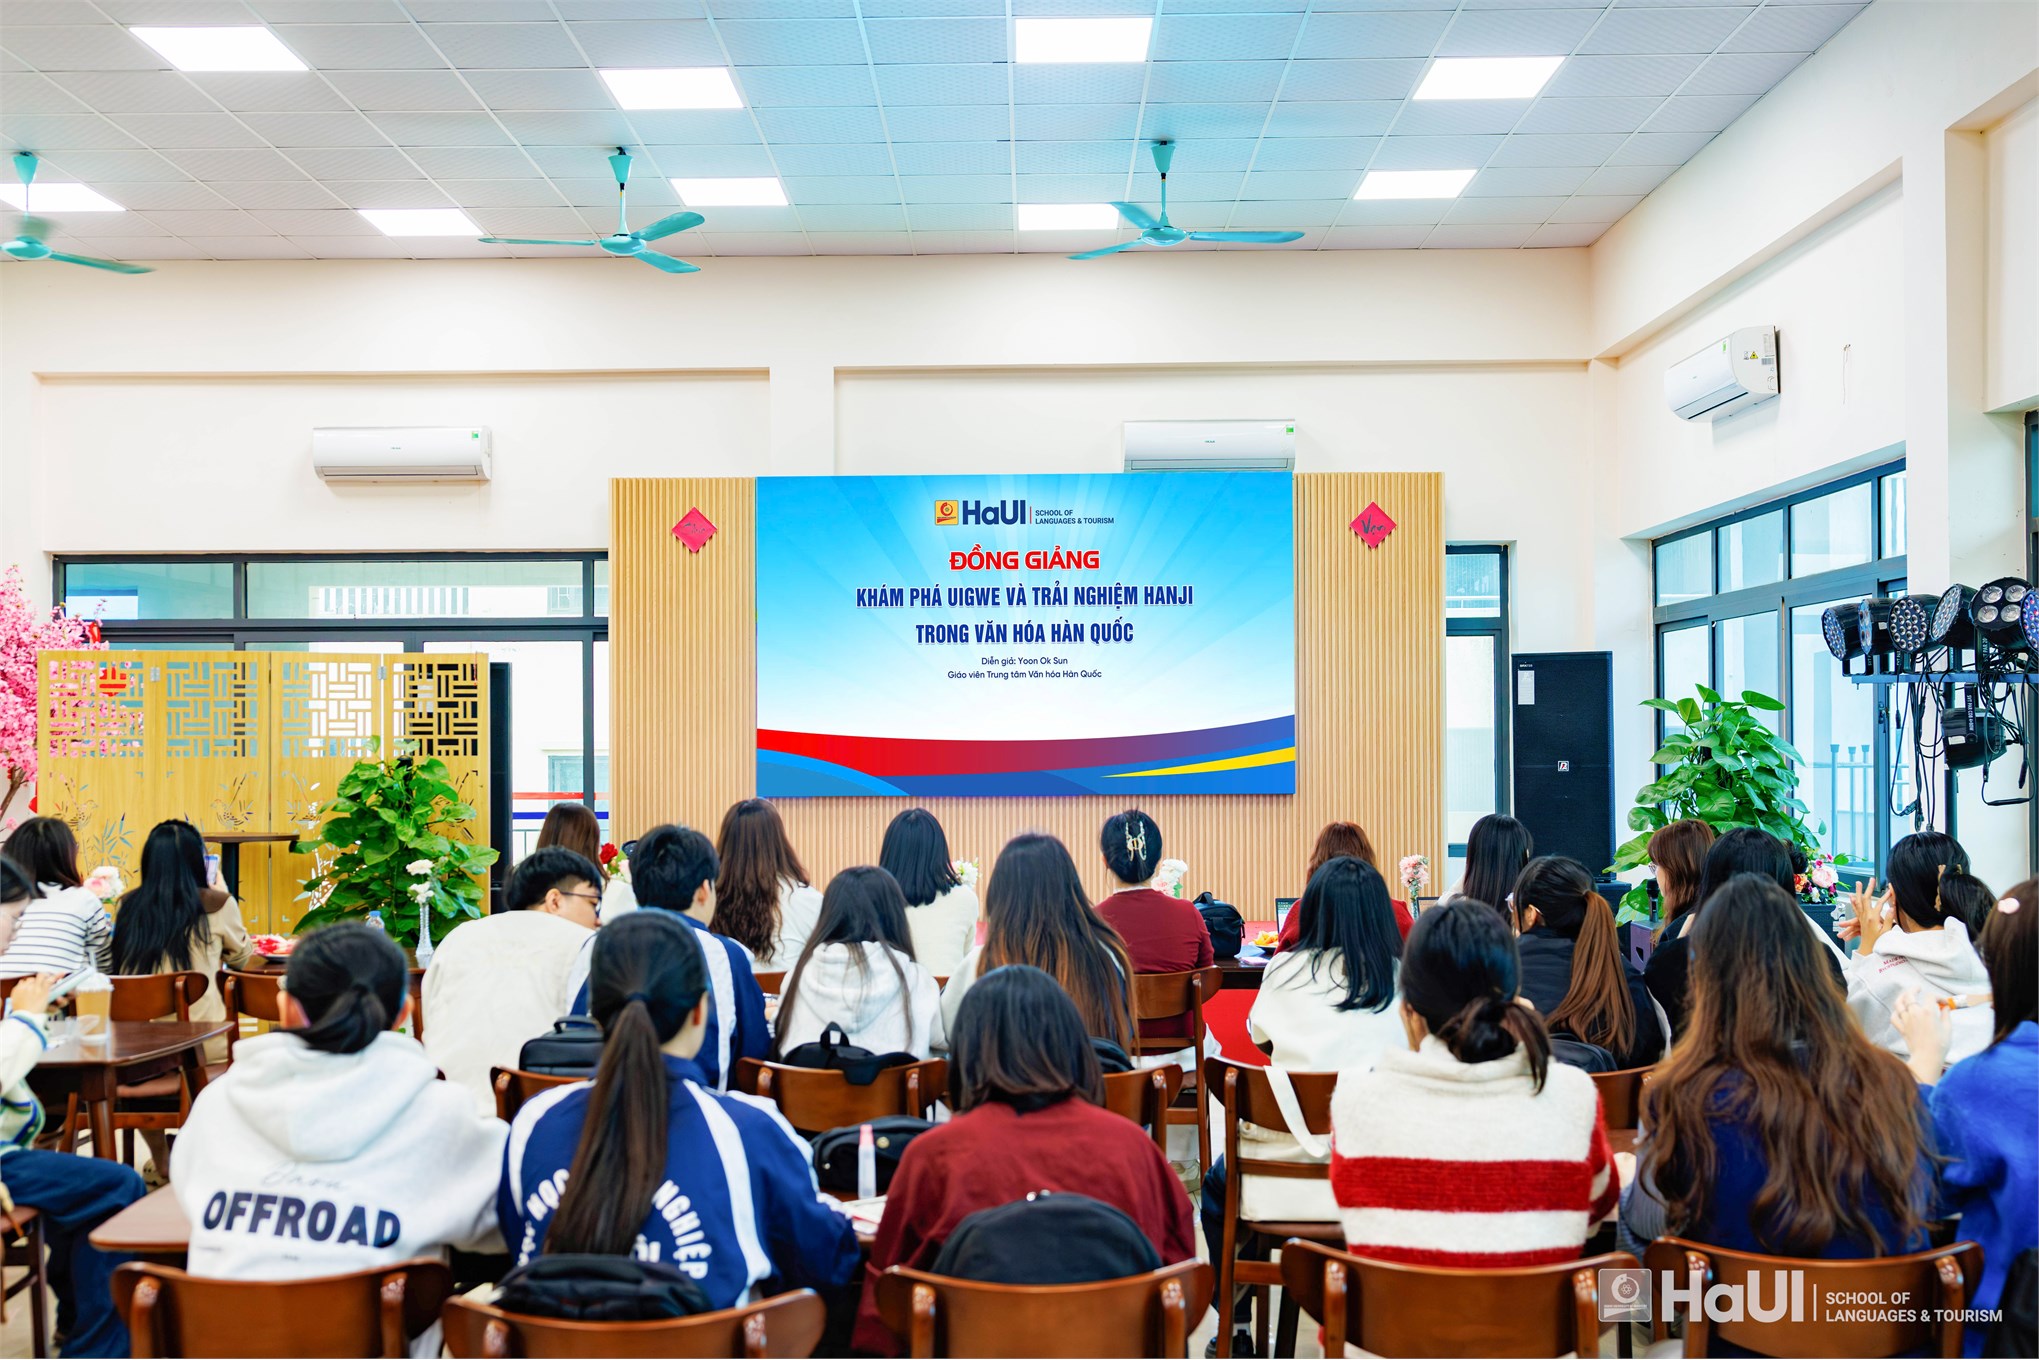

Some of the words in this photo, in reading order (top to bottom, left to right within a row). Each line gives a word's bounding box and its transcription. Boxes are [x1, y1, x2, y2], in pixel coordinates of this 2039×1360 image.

[962, 499, 1026, 526] HaUI
[1035, 509, 1063, 517] SCHOOL
[1063, 509, 1074, 517] OF
[1035, 517, 1076, 525] LANGUAGES
[1077, 517, 1083, 525] &
[949, 543, 1020, 571] ĐỒNG
[1024, 545, 1100, 570] GIẢNG
[856, 584, 904, 607] KHÁM
[910, 583, 942, 607] PHÁ
[948, 587, 1000, 606] UIGWE
[1005, 582, 1027, 606] VÀ
[1031, 580, 1068, 606] TRẢI
[1074, 582, 1138, 610] NGHIỆM
[1144, 585, 1194, 605] HANJI
[915, 624, 969, 644] TRONG
[974, 620, 1007, 643] VĂN
[1013, 619, 1046, 643] HÓA
[1051, 619, 1085, 643] HÀN
[1090, 616, 1134, 645] QUỐC
[947, 670, 967, 679] Giáo
[968, 670, 985, 679] viên
[987, 671, 1009, 680] Trung
[1028, 670, 1044, 678] Văn
[1045, 669, 1061, 678] hóa
[1062, 669, 1078, 678] Hàn
[1080, 669, 1102, 678] Quốc
[981, 656, 999, 665] Diễn
[1001, 657, 1016, 667] giả:
[1018, 657, 1038, 665] Yoon
[1039, 656, 1052, 665] Ok
[1053, 656, 1068, 665] Sun
[203, 1191, 401, 1248] OFFROAD
[652, 1179, 712, 1280] NGHIỆP
